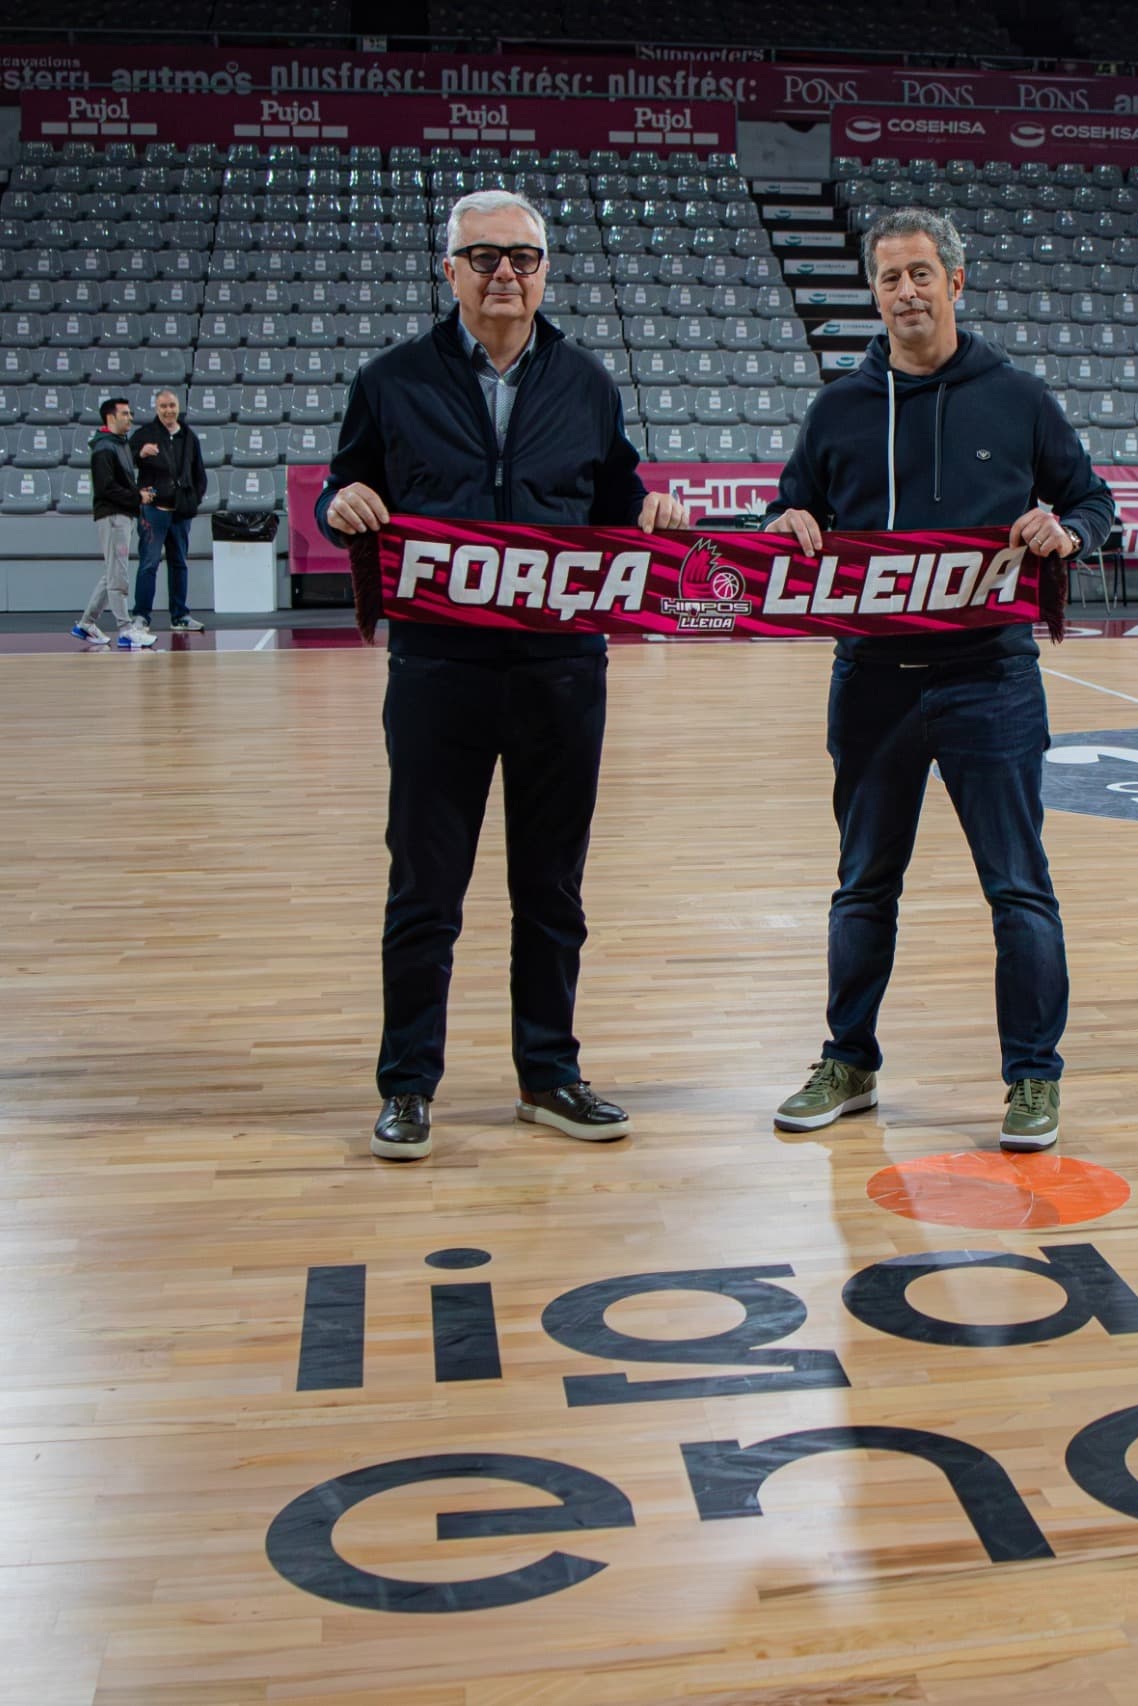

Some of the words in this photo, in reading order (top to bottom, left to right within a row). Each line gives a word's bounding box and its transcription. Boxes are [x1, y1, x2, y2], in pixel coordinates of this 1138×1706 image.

[0, 65, 89, 90] sterri
[784, 75, 858, 103] PONS
[68, 97, 130, 122] Pujol
[260, 100, 321, 125] Pujol
[449, 104, 509, 129] Pujol
[634, 107, 693, 132] Pujol
[887, 118, 986, 136] COSEHISA
[397, 540, 651, 621] FORÇA
[762, 546, 1029, 615] LLEIDA
[680, 617, 732, 629] LLEIDA
